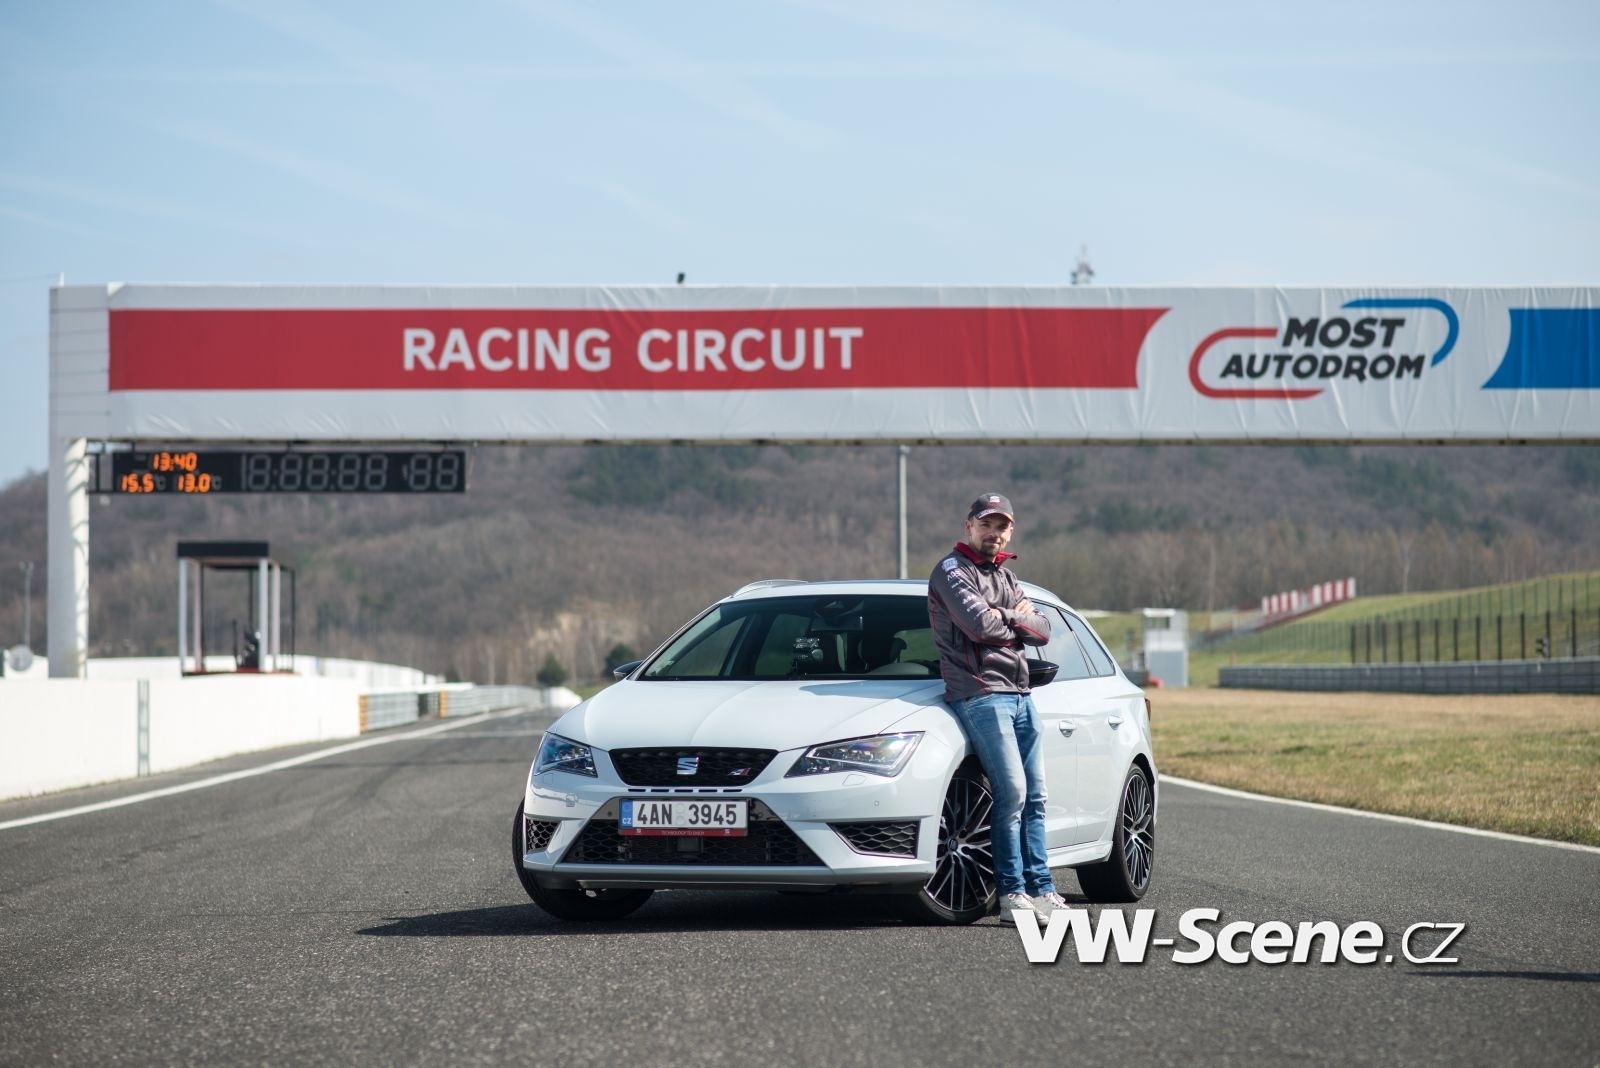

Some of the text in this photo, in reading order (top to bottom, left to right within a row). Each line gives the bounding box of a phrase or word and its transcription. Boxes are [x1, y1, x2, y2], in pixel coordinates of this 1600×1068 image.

[1281, 316, 1406, 349] MOST
[403, 326, 864, 372] RACING CIRCUIT
[1219, 353, 1426, 383] AUTODROM
[153, 452, 198, 472] 13:40
[621, 817, 632, 825] CZ
[637, 803, 737, 825] 4AN 3945
